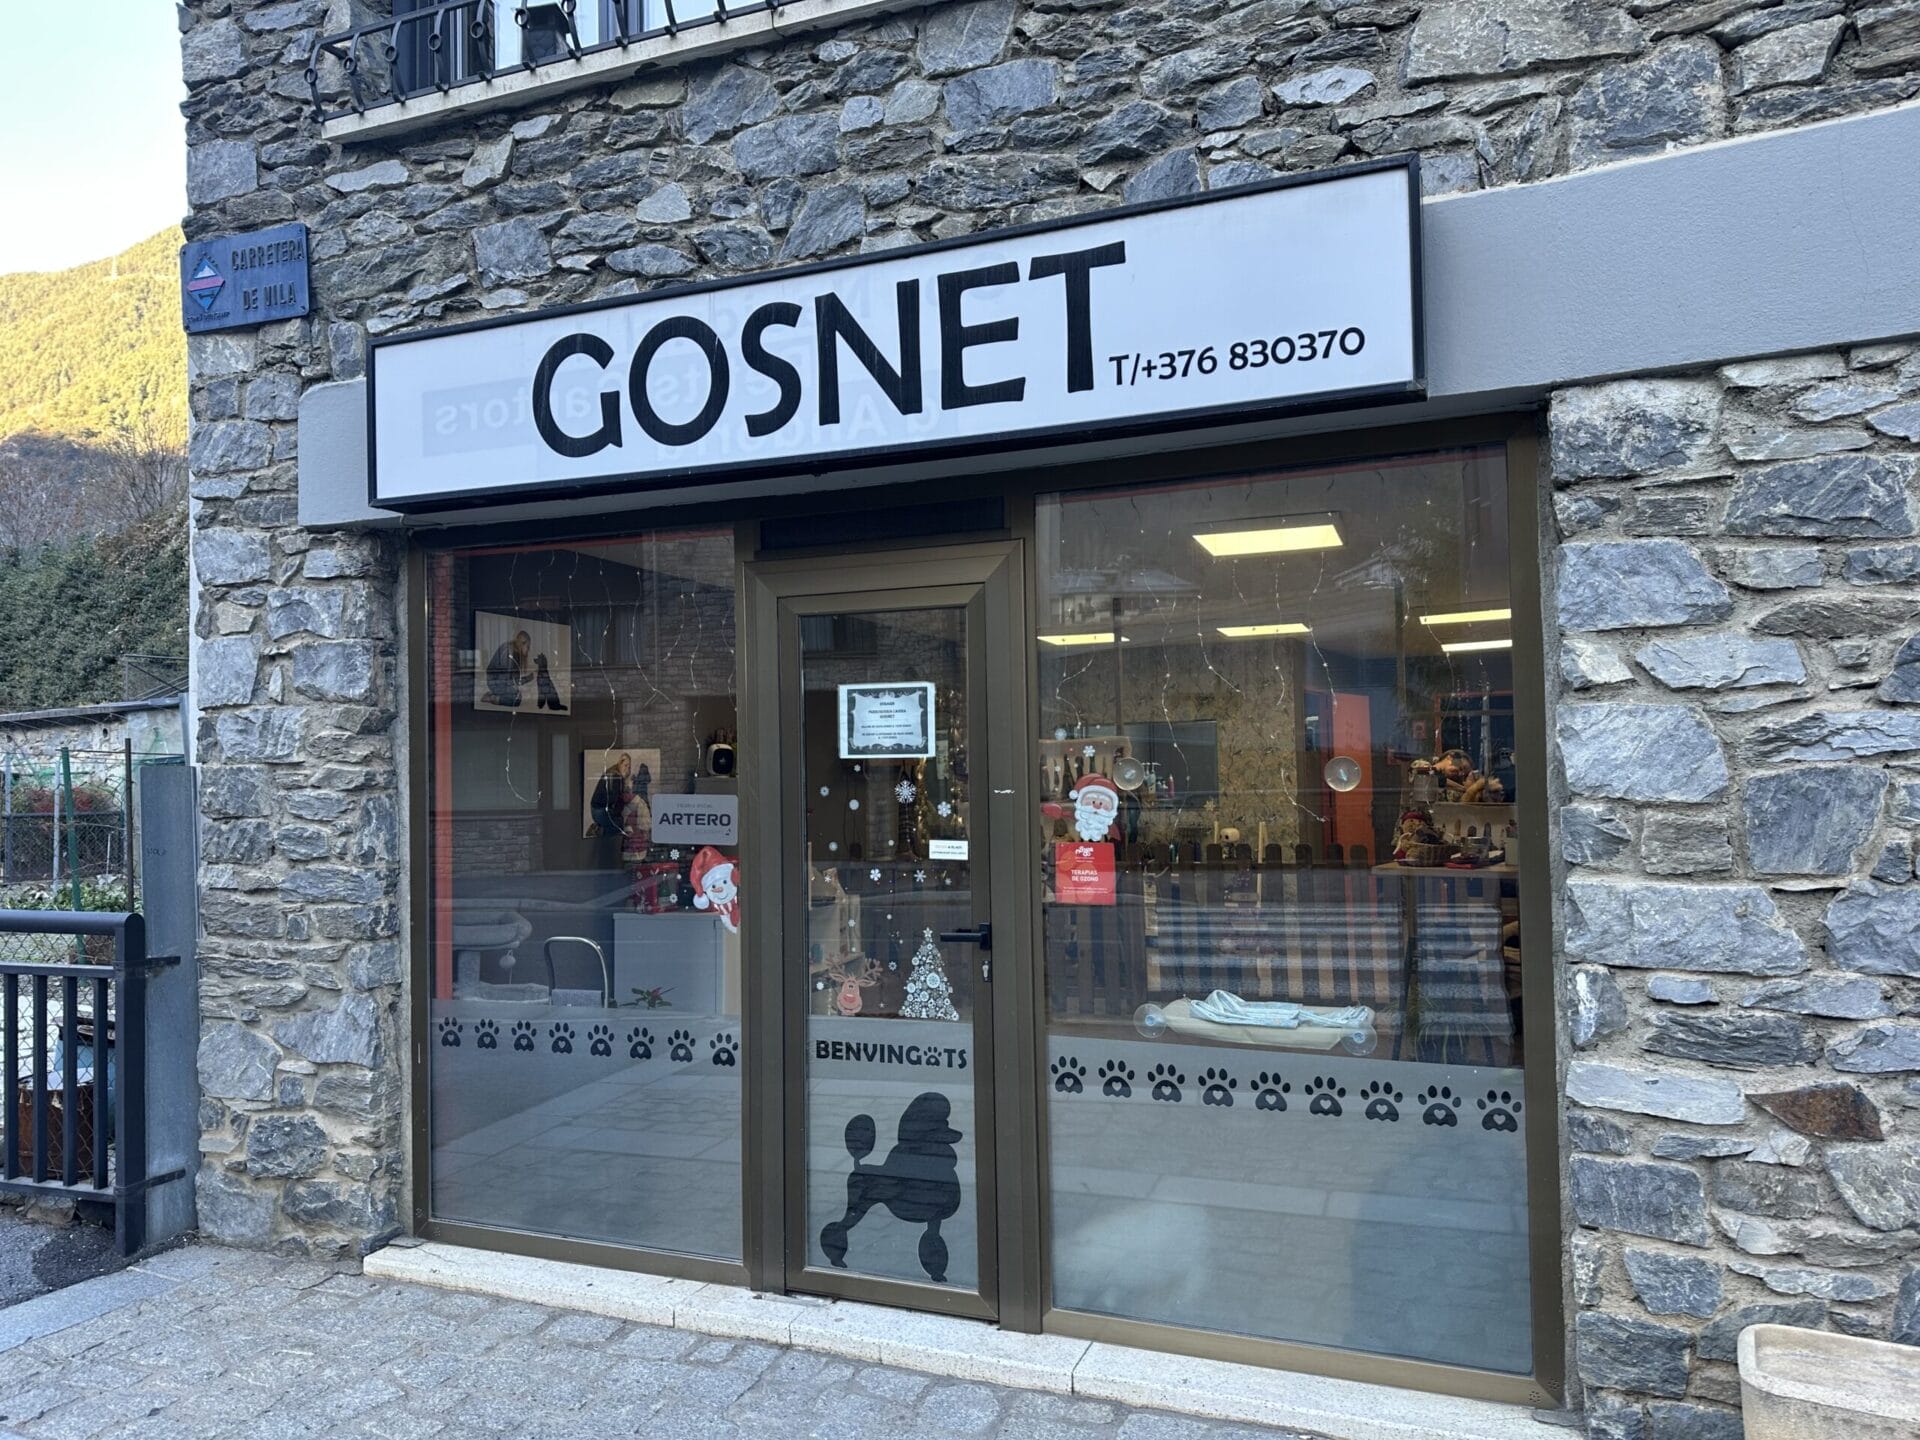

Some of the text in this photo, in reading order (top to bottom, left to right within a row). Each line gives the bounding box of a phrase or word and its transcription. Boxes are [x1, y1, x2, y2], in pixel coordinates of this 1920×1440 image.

[231, 238, 305, 271] CARRETERA
[243, 282, 297, 311] DE VILA
[533, 241, 1125, 458] GOSNET
[1108, 327, 1366, 386] T/+376 830370
[659, 812, 732, 827] ARTERO
